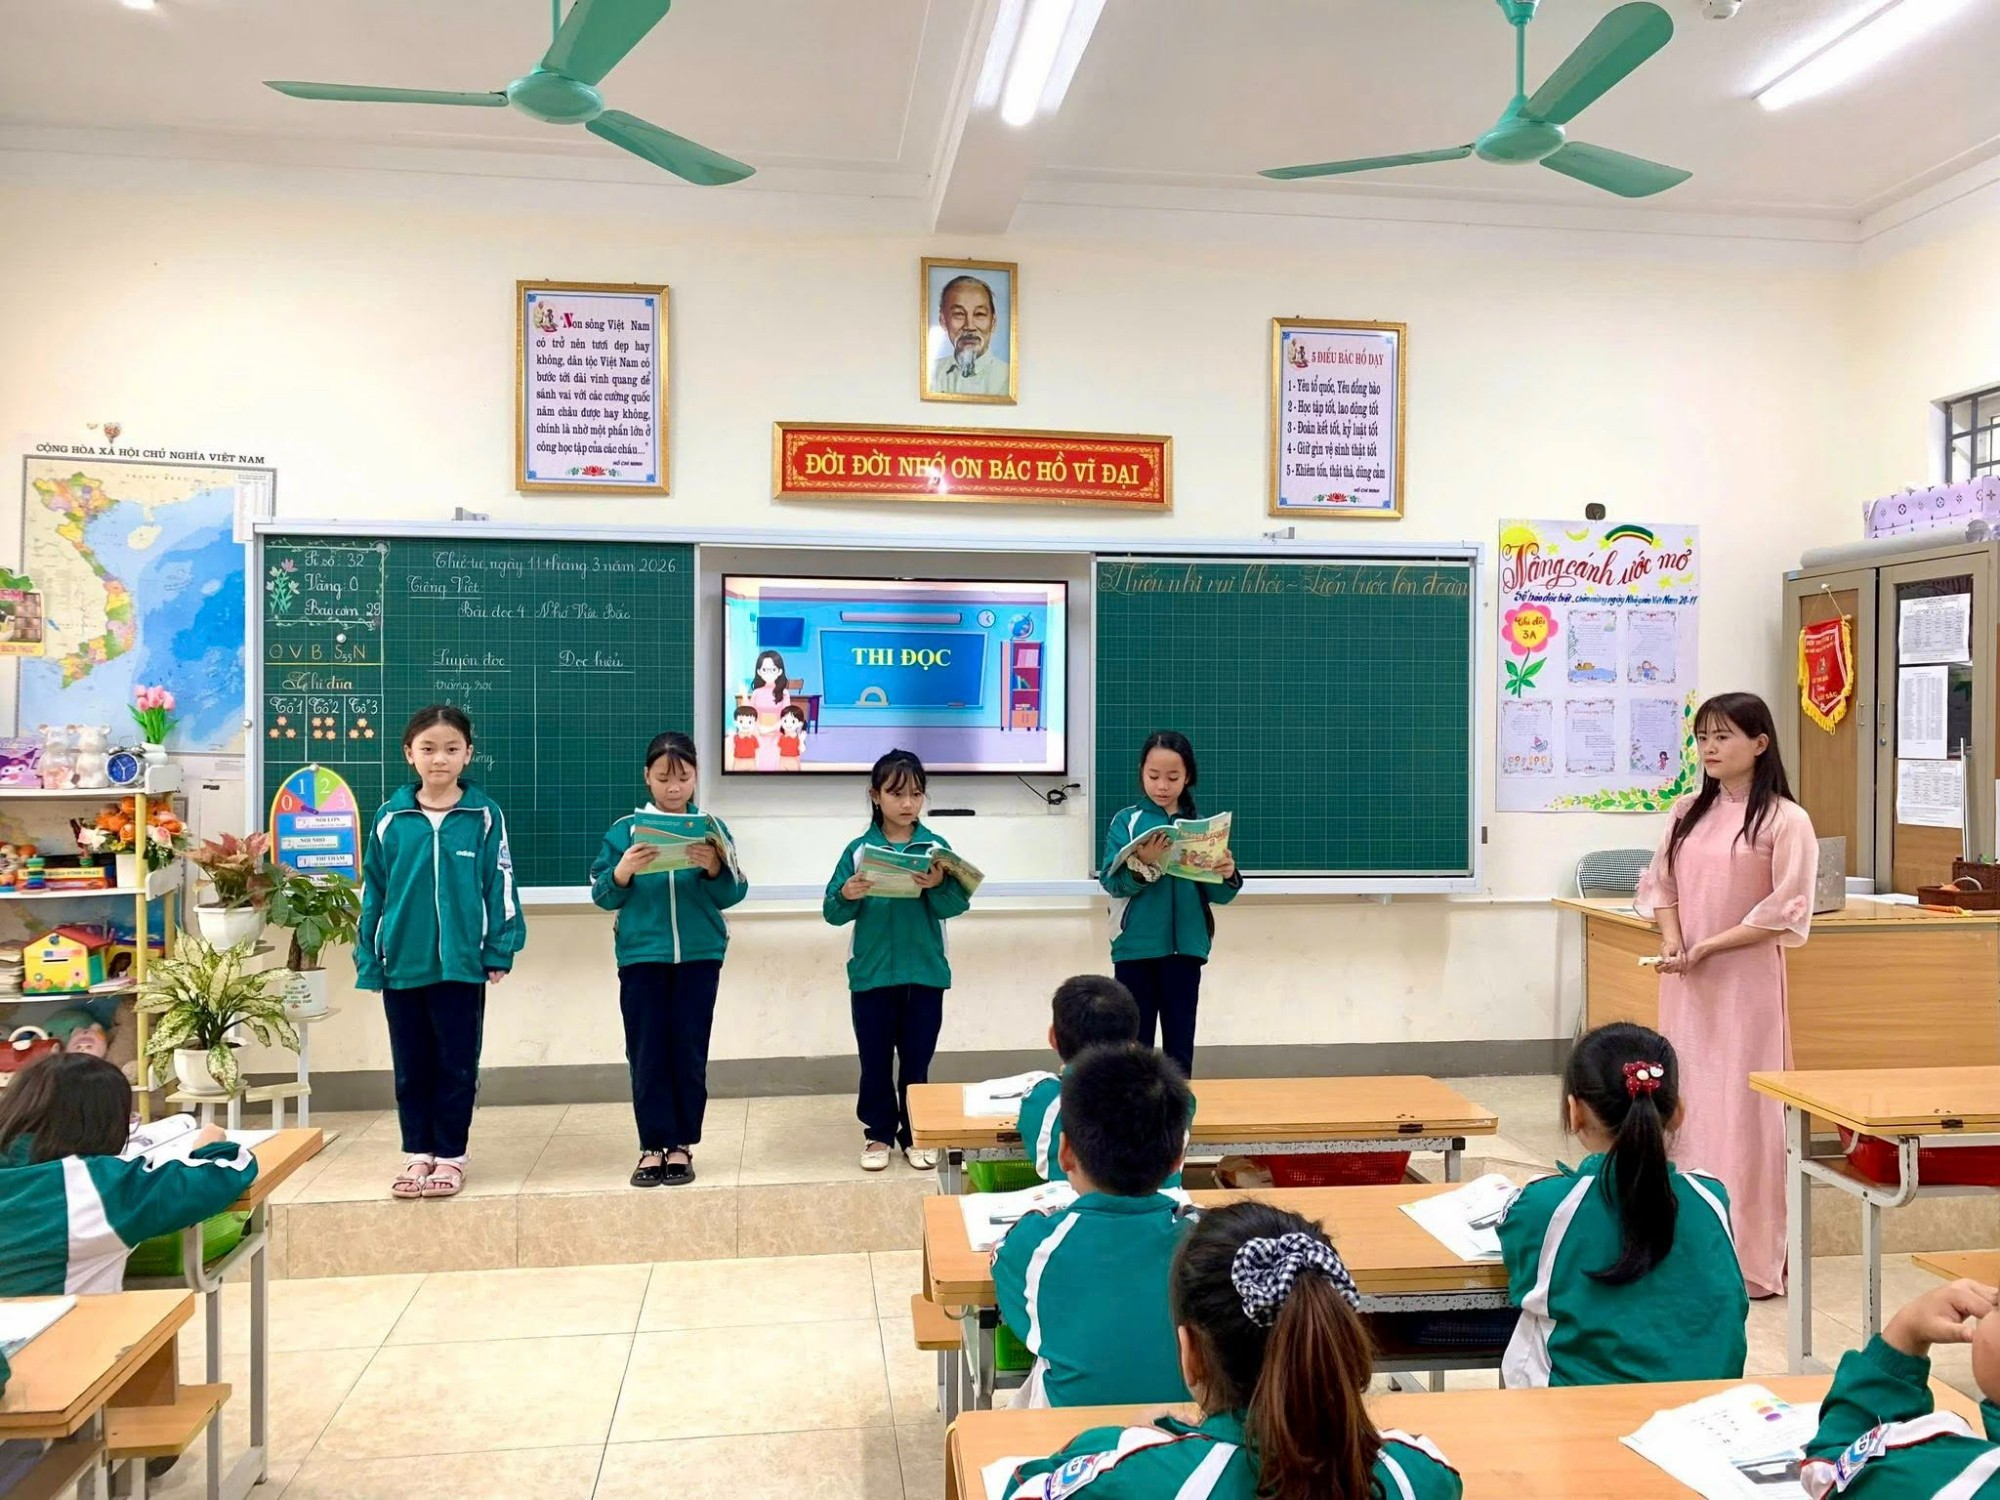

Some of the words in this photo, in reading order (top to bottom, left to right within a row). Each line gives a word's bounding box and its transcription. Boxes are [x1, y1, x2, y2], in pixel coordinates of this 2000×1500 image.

[585, 318, 604, 332] sông
[608, 319, 624, 332] Việt
[631, 320, 650, 330] Nam
[536, 337, 546, 348] có
[553, 336, 565, 348] trở
[571, 339, 585, 349] nên
[592, 340, 608, 350] tươi
[615, 340, 629, 353] đẹp
[635, 341, 650, 353] hay
[567, 354, 582, 366] dân
[586, 354, 598, 368] tộc
[600, 356, 617, 369] Việt
[620, 357, 638, 368] Nam
[641, 357, 650, 368] có
[1312, 352, 1316, 362] 5
[1317, 347, 1336, 363] ĐIỀU
[1339, 350, 1352, 364] BÁC
[1356, 348, 1367, 365] HỒ
[1369, 354, 1384, 368] DẠY
[537, 372, 556, 382] bước
[560, 372, 570, 383] tới
[590, 374, 609, 384] vinh
[612, 376, 638, 387] quang
[641, 371, 651, 385] để
[1297, 379, 1310, 392] Yêu
[1337, 381, 1349, 394] Yêu
[1369, 382, 1380, 395] bào
[537, 388, 556, 400] sánh
[559, 390, 571, 400] vai
[574, 390, 586, 400] với
[589, 390, 602, 401] các
[604, 391, 629, 404] cường
[631, 390, 650, 404] quốc
[558, 406, 578, 417] châu
[581, 407, 600, 420] được
[604, 408, 618, 420] hay
[1298, 400, 1311, 416] Học
[1313, 401, 1323, 416] tập
[1338, 402, 1348, 414] lao
[1369, 400, 1378, 415] tốt
[537, 423, 560, 434] chính
[562, 424, 570, 434] là
[573, 424, 588, 435] nhờ
[590, 425, 606, 437] một
[631, 425, 644, 436] lớn
[1298, 421, 1315, 434] Đoàn
[1317, 420, 1328, 434] kết
[1353, 423, 1366, 438] luật
[1369, 421, 1378, 436] tốt
[36, 442, 68, 453] CỘNG
[72, 444, 95, 454] HÒA
[98, 446, 115, 455] XÃ
[119, 447, 139, 458] HỘI
[143, 448, 166, 458] CHỦ
[170, 451, 205, 460] NGHĨA
[209, 452, 236, 462] VIỆT
[239, 455, 265, 464] NAM
[537, 441, 556, 454] công
[558, 442, 572, 455] học
[574, 442, 587, 455] tập
[588, 441, 602, 453] của
[604, 443, 616, 454] các
[1297, 442, 1310, 454] Giữ
[1325, 442, 1333, 458] vệ
[1335, 443, 1350, 456] sinh
[1352, 443, 1365, 460] thật
[1367, 441, 1376, 456] tốt
[806, 447, 846, 475] ĐỜI
[852, 448, 891, 476] ĐỜI
[898, 451, 946, 478] NHỚ
[952, 456, 983, 479] ƠN
[989, 453, 1031, 480] BÁC
[1036, 451, 1067, 482] HỒ
[1072, 458, 1095, 483] VĨ
[1101, 464, 1139, 490] ĐẠI
[1296, 463, 1315, 476] Khiêm
[1330, 464, 1342, 480] thật
[1356, 465, 1371, 481] dũng
[1373, 463, 1385, 478] cảm
[347, 553, 364, 567] 32
[433, 551, 466, 569] Thứ
[490, 558, 524, 578] ngày
[528, 556, 540, 570] 11
[543, 553, 589, 580] tháng
[592, 557, 600, 572] 3
[603, 561, 636, 572] năm
[639, 558, 676, 572] 2026
[1502, 542, 1572, 594] Nâng
[1565, 550, 1616, 586] cánh
[1618, 551, 1652, 585] ước
[1658, 548, 1692, 571] mơ
[350, 576, 358, 591] 0
[406, 575, 447, 600] Tiếng
[1098, 562, 1162, 595] Thiếu
[1169, 564, 1203, 592] nhi
[1208, 576, 1235, 592] vui
[1299, 565, 1346, 597] Tiến
[1352, 566, 1387, 595] bước
[1392, 566, 1416, 595] lên
[1514, 590, 1530, 601] Số
[1679, 595, 1698, 605] 20-11
[304, 598, 333, 616] Báo
[366, 602, 381, 616] 29
[458, 600, 489, 617] Bài
[517, 604, 524, 618] 4
[535, 601, 568, 618] Nhớ
[603, 603, 630, 619] Bắc
[1523, 630, 1536, 640] 3A
[269, 644, 282, 658] O
[289, 644, 303, 659] V
[312, 644, 322, 660] B
[852, 647, 894, 666] THI
[900, 649, 951, 671] ĐỌC
[270, 697, 296, 713] Tổ
[297, 700, 303, 714] 1
[308, 697, 332, 714] Tổ
[332, 701, 339, 714] 2
[349, 697, 370, 713] Tổ
[370, 700, 378, 714] 3
[298, 778, 305, 794] 1
[320, 778, 330, 793] 2
[282, 795, 292, 810] 0
[338, 793, 346, 808] 3
